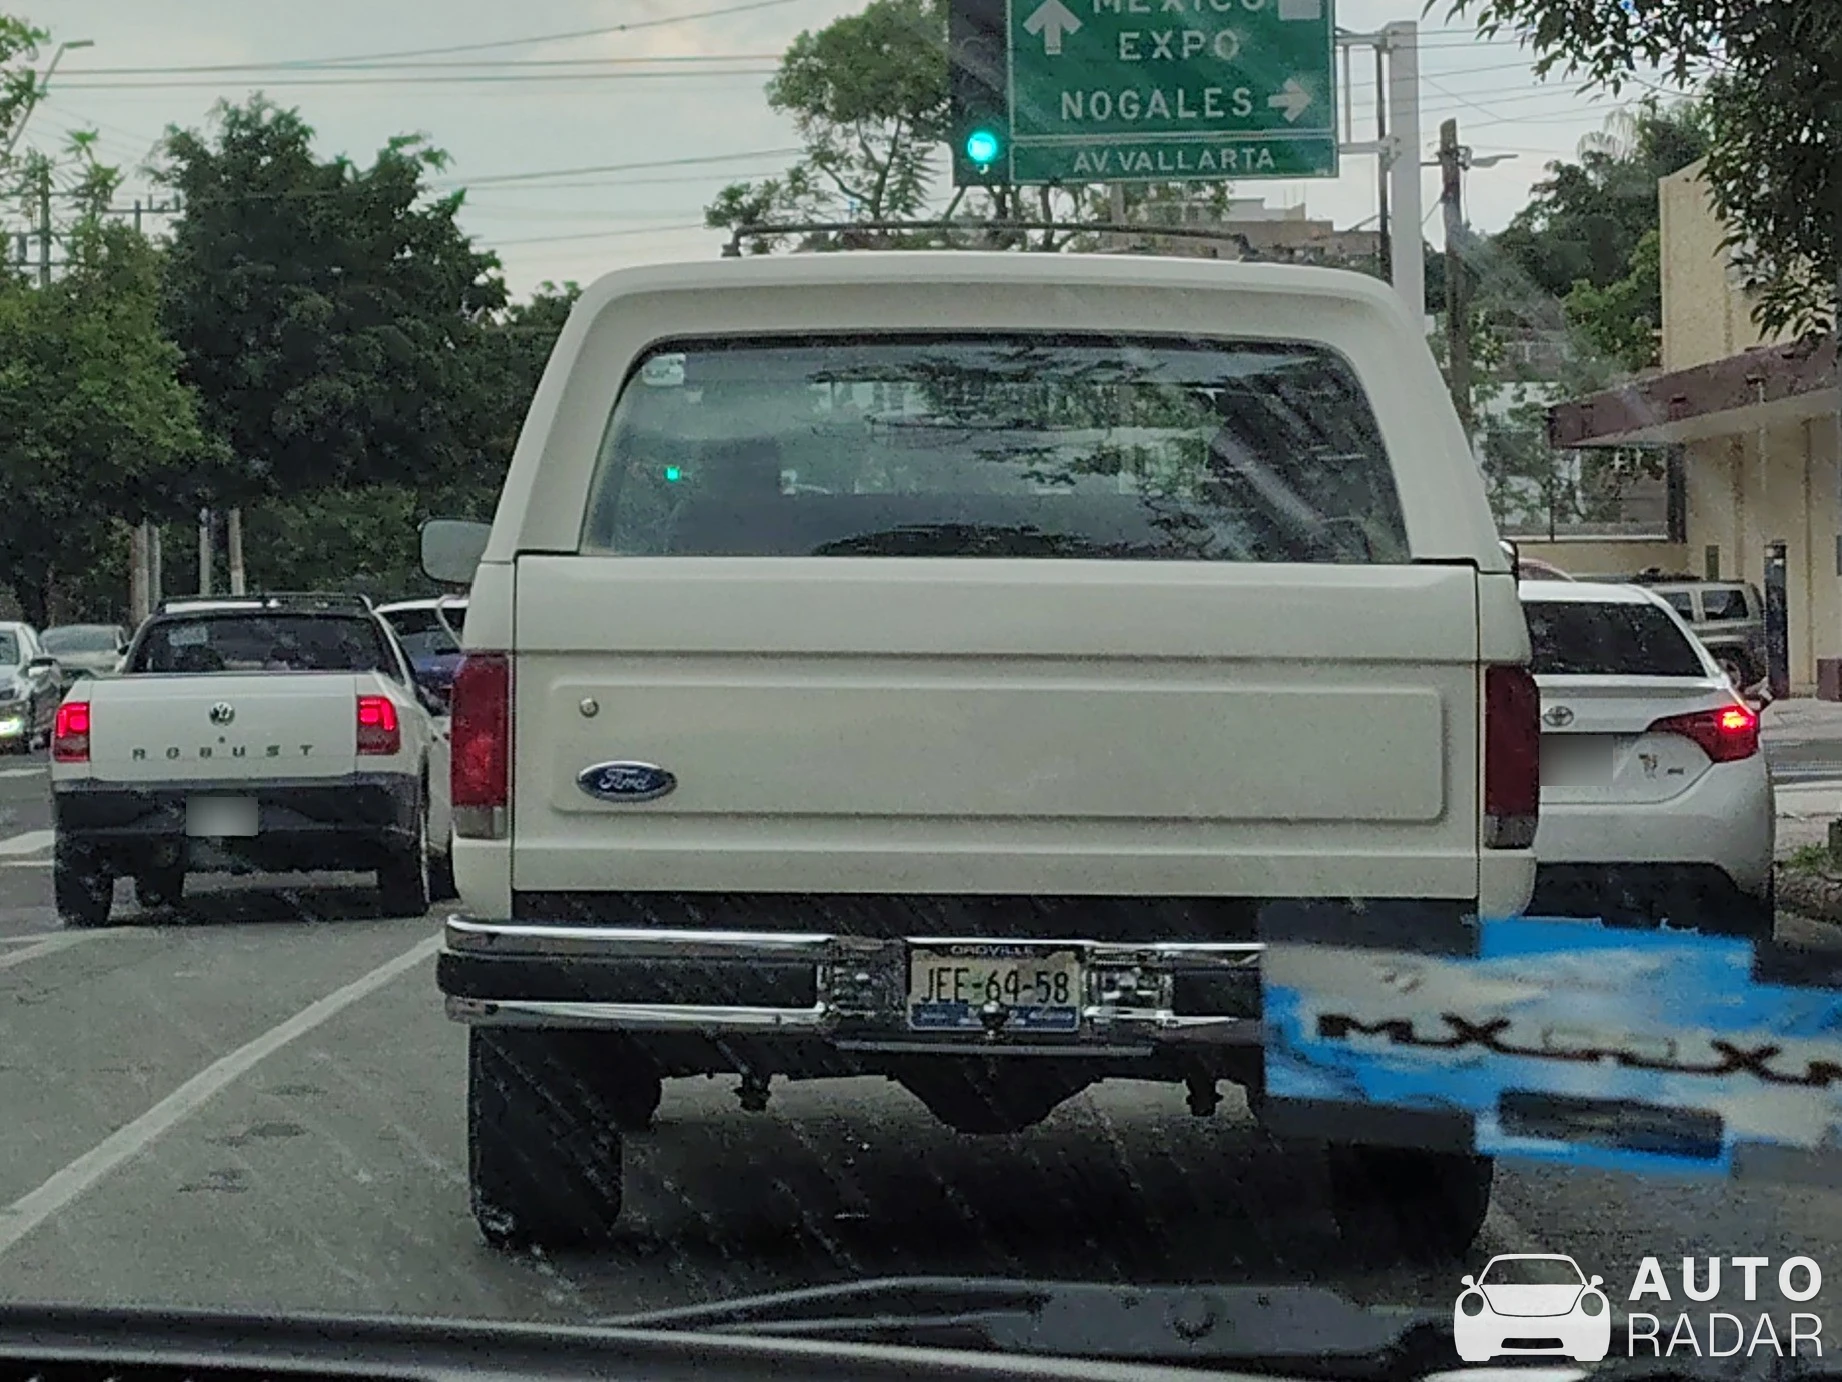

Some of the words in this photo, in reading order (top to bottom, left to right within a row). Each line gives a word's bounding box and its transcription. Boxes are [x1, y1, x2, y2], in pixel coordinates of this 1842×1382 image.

[1119, 29, 1239, 60] EXPO
[1061, 87, 1253, 120] NOGALES
[1118, 148, 1275, 171] VALLARTA
[132, 745, 313, 761] ROBUST
[599, 768, 650, 790] Ford
